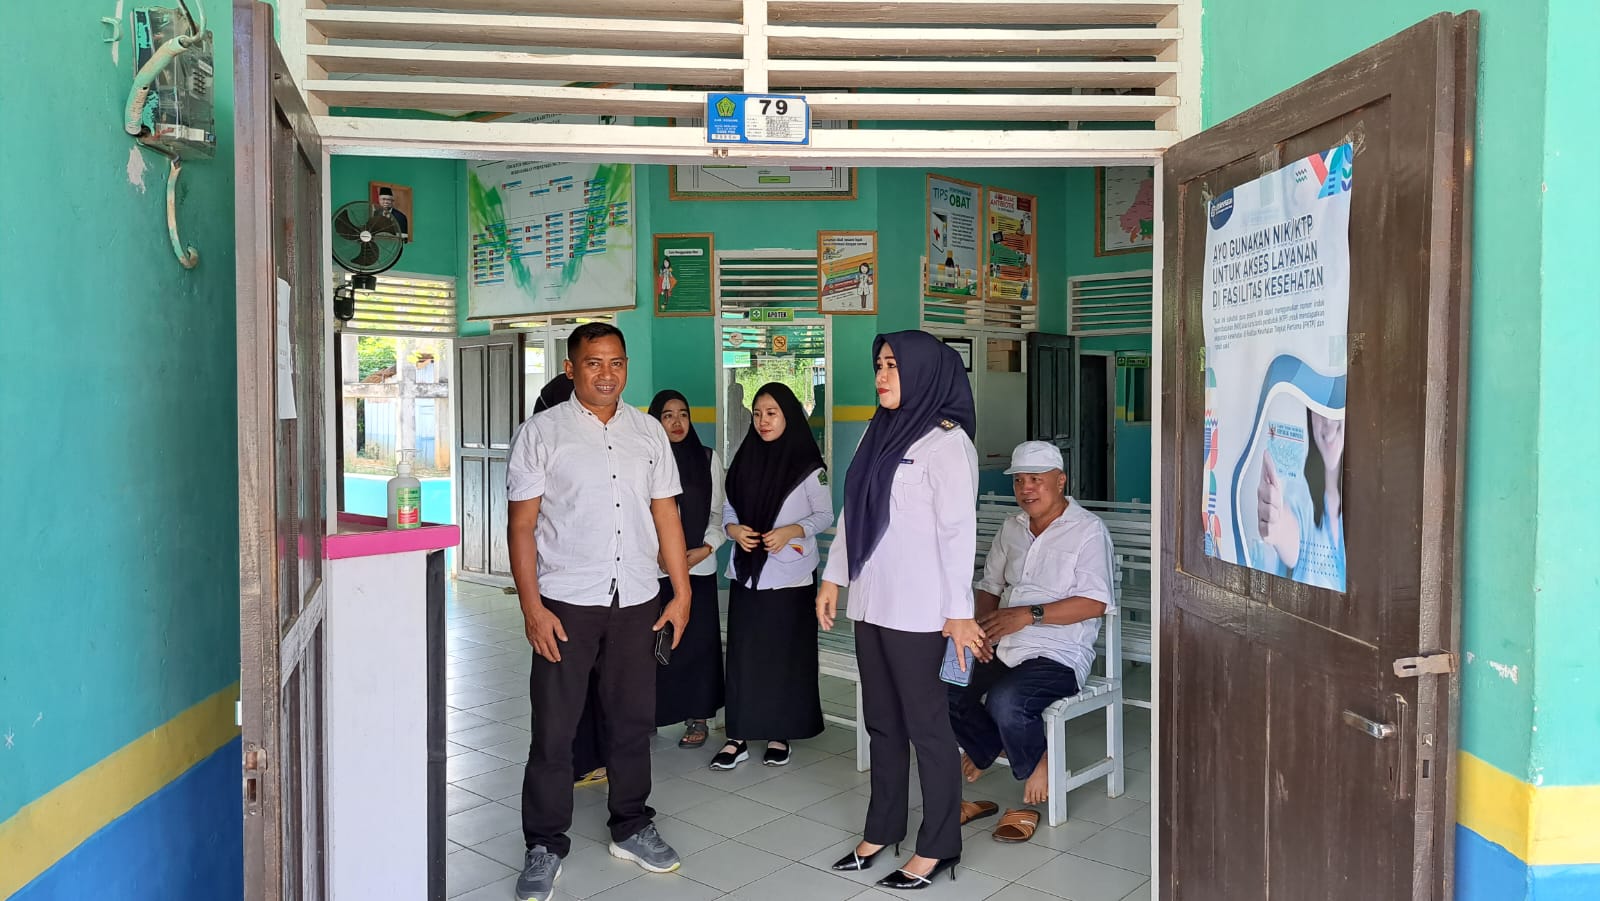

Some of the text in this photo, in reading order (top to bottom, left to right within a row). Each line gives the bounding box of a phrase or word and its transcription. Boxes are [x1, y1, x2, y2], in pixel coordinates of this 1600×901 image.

[759, 99, 788, 115] 79
[932, 187, 949, 201] TIPS
[949, 194, 971, 209] OBAT
[1213, 214, 1313, 261] AYO GUNAKAN NIK/KTP
[1212, 240, 1318, 285] UNTUK AKSES LAYANAN
[1212, 266, 1324, 308] DI FASILITAS KESEHATAN
